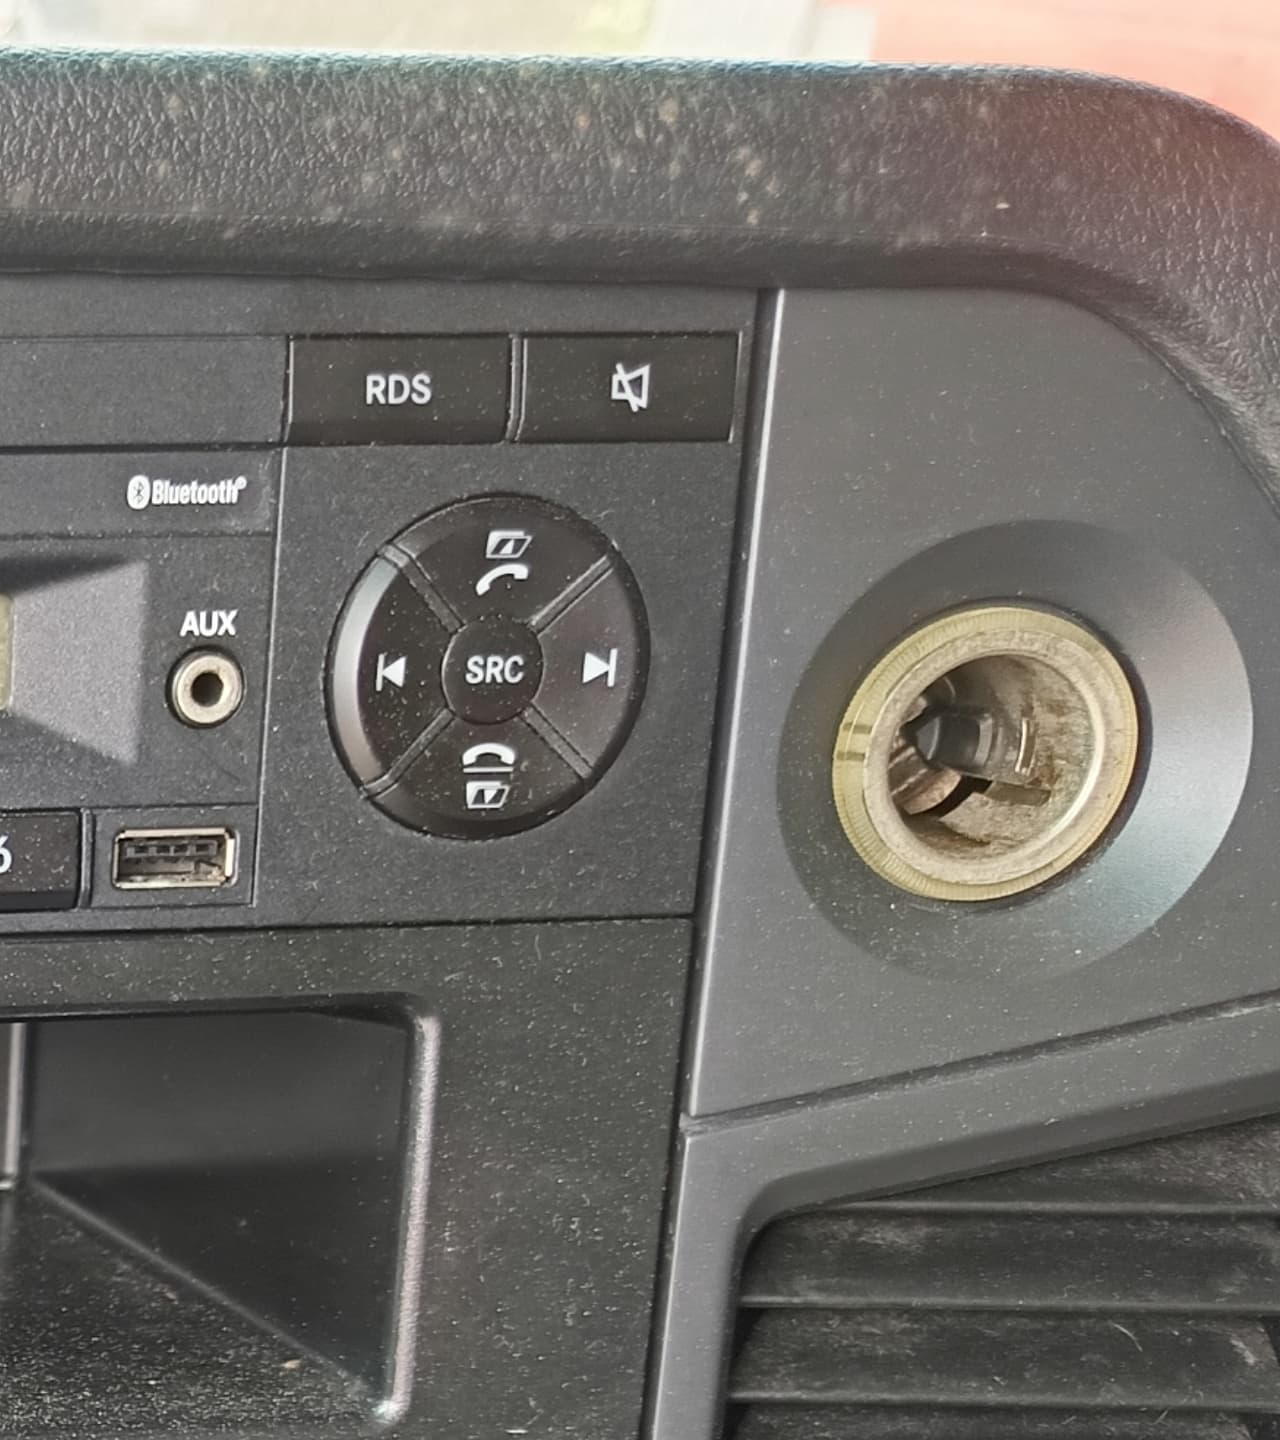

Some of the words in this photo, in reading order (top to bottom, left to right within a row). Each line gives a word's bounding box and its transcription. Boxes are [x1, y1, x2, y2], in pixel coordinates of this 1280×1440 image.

[366, 372, 432, 405] RDS
[179, 609, 238, 637] AUX
[465, 655, 524, 684] SRC
